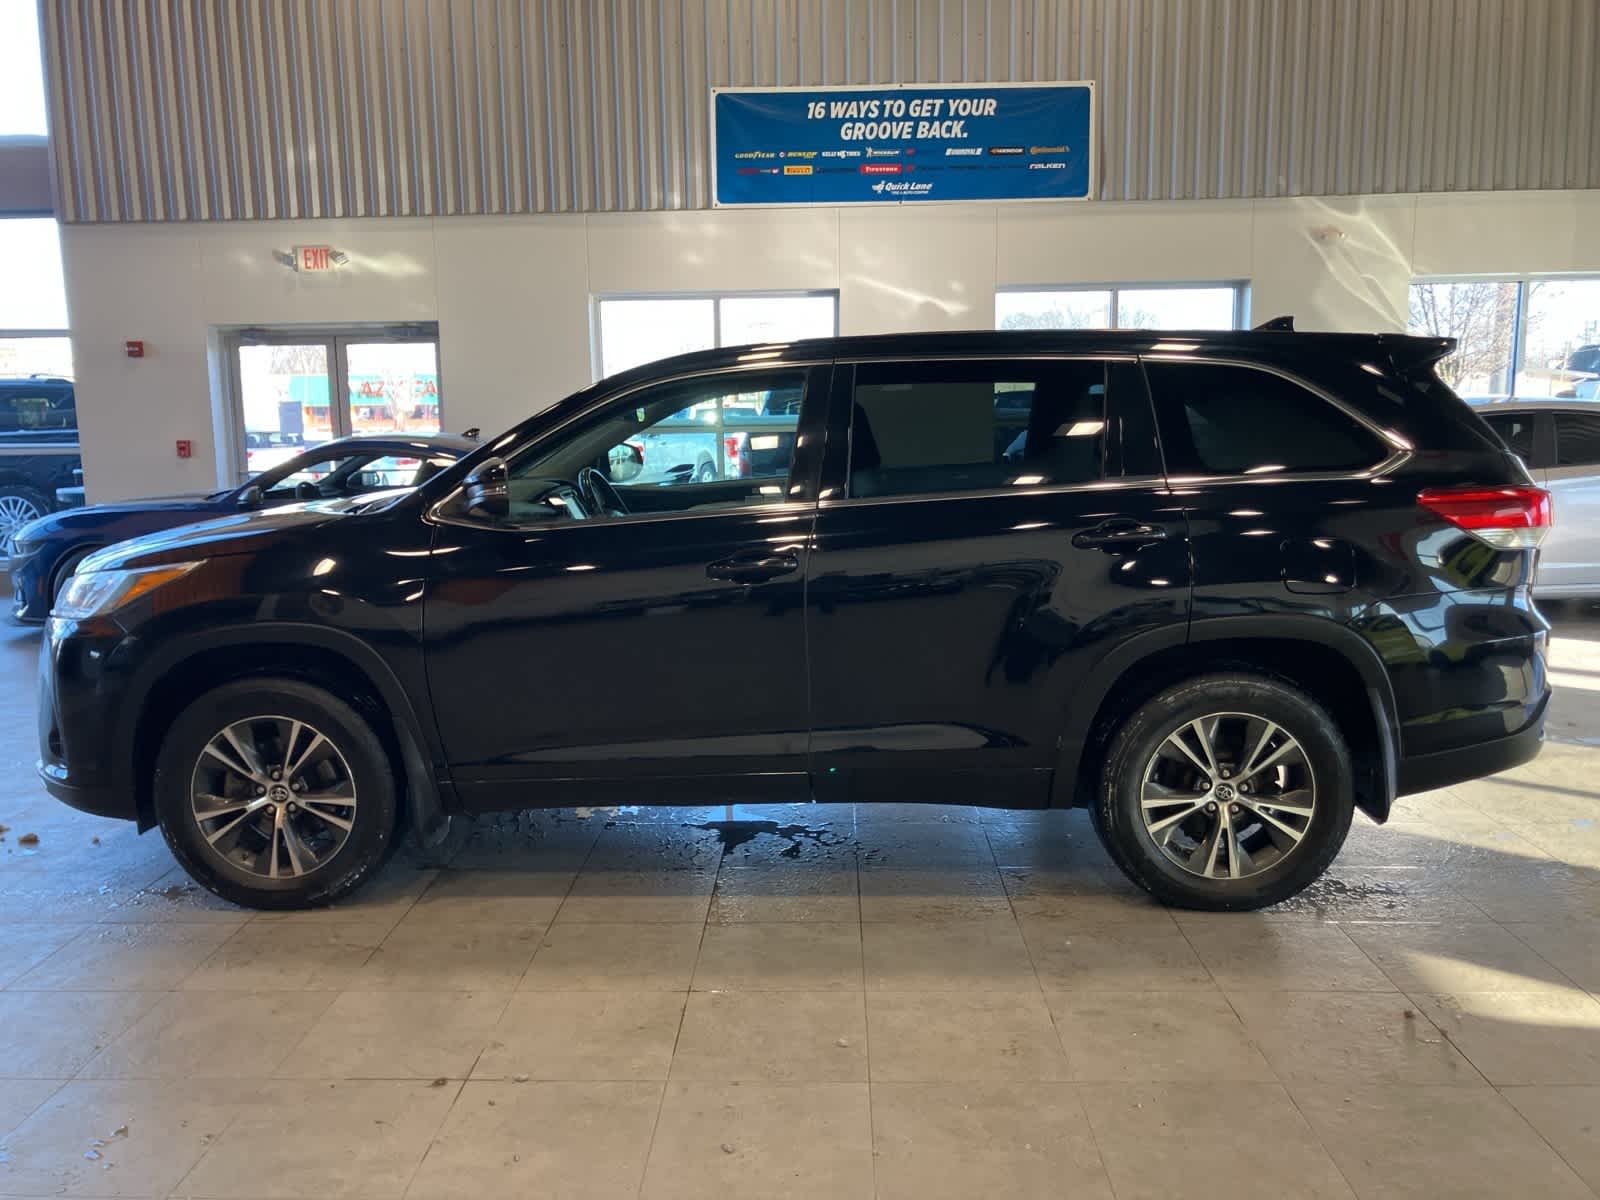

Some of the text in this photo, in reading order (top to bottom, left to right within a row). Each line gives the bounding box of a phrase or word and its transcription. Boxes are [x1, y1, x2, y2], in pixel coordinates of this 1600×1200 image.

[807, 98, 997, 119] 16 WAYS TO GET YOUR
[840, 120, 968, 140] GROOVE BACK.
[734, 151, 775, 159] GOODYEAR
[885, 181, 933, 191] Quick Lane
[303, 247, 330, 270] EXIT
[361, 380, 437, 398] AZCA
